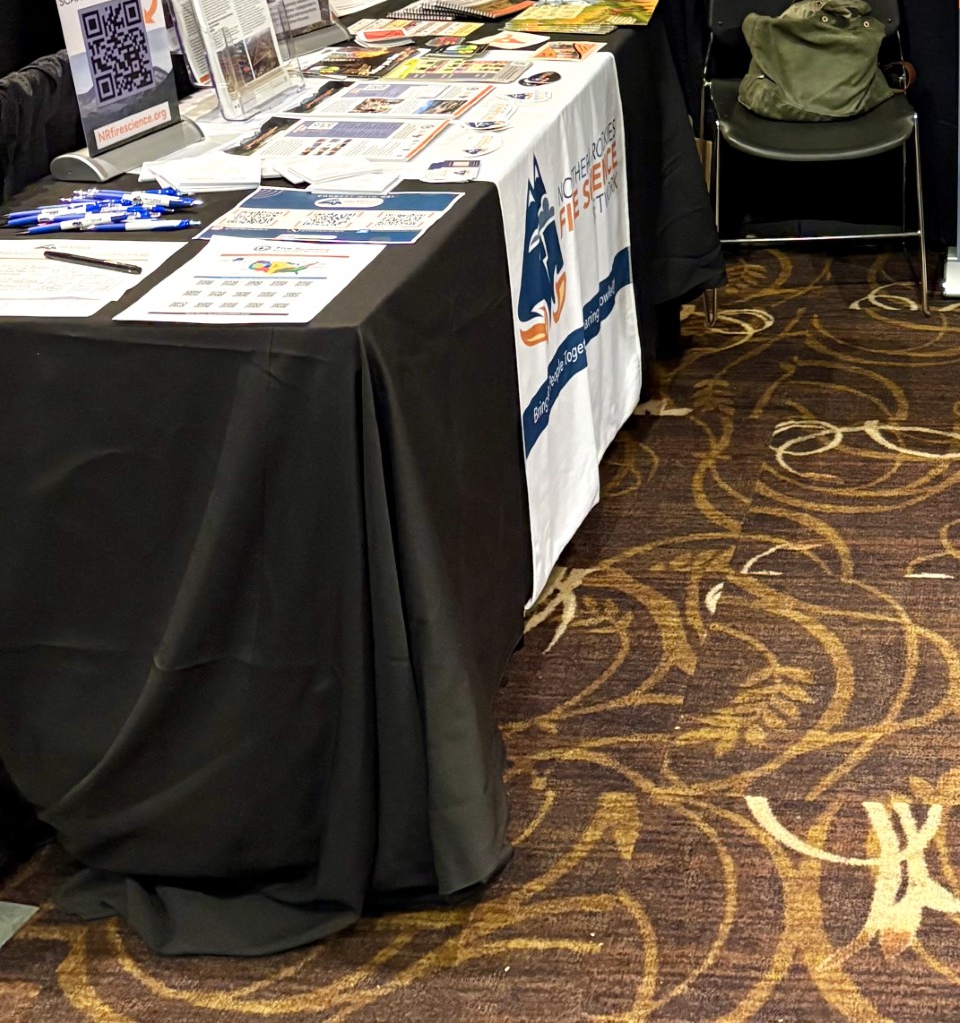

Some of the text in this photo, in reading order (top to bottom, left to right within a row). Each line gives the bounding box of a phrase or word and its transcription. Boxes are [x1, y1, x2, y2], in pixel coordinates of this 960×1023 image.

[97, 109, 167, 142] NRfirescience.org
[559, 141, 618, 240] FIE SIENCE
